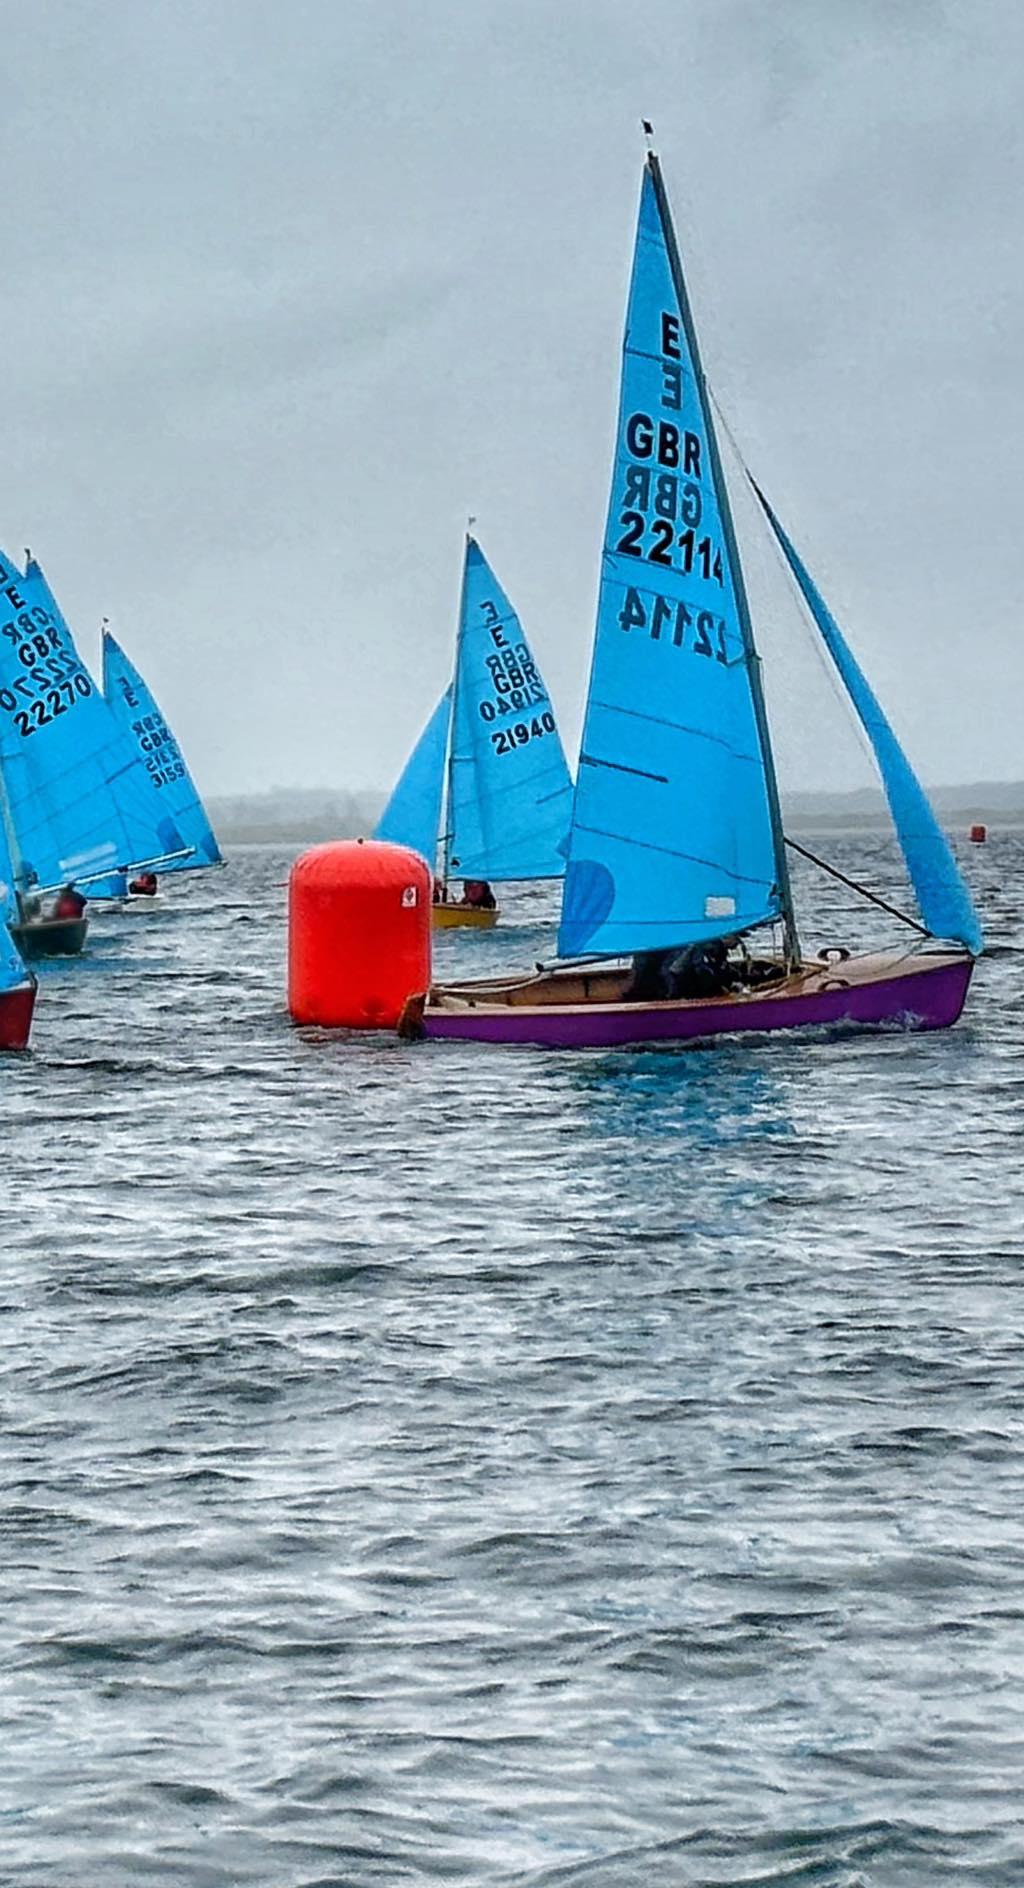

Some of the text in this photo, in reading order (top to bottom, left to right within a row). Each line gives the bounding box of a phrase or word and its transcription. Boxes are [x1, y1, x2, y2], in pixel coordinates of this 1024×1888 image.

[662, 312, 681, 360] E
[626, 412, 702, 481] GBR
[616, 511, 724, 590] 22114
[5, 585, 26, 610] E
[19, 626, 63, 668] GBR
[490, 625, 510, 648] E
[494, 662, 538, 695] GBR
[14, 674, 91, 737] 22270
[140, 727, 171, 752] GBR
[491, 711, 556, 755] 21940
